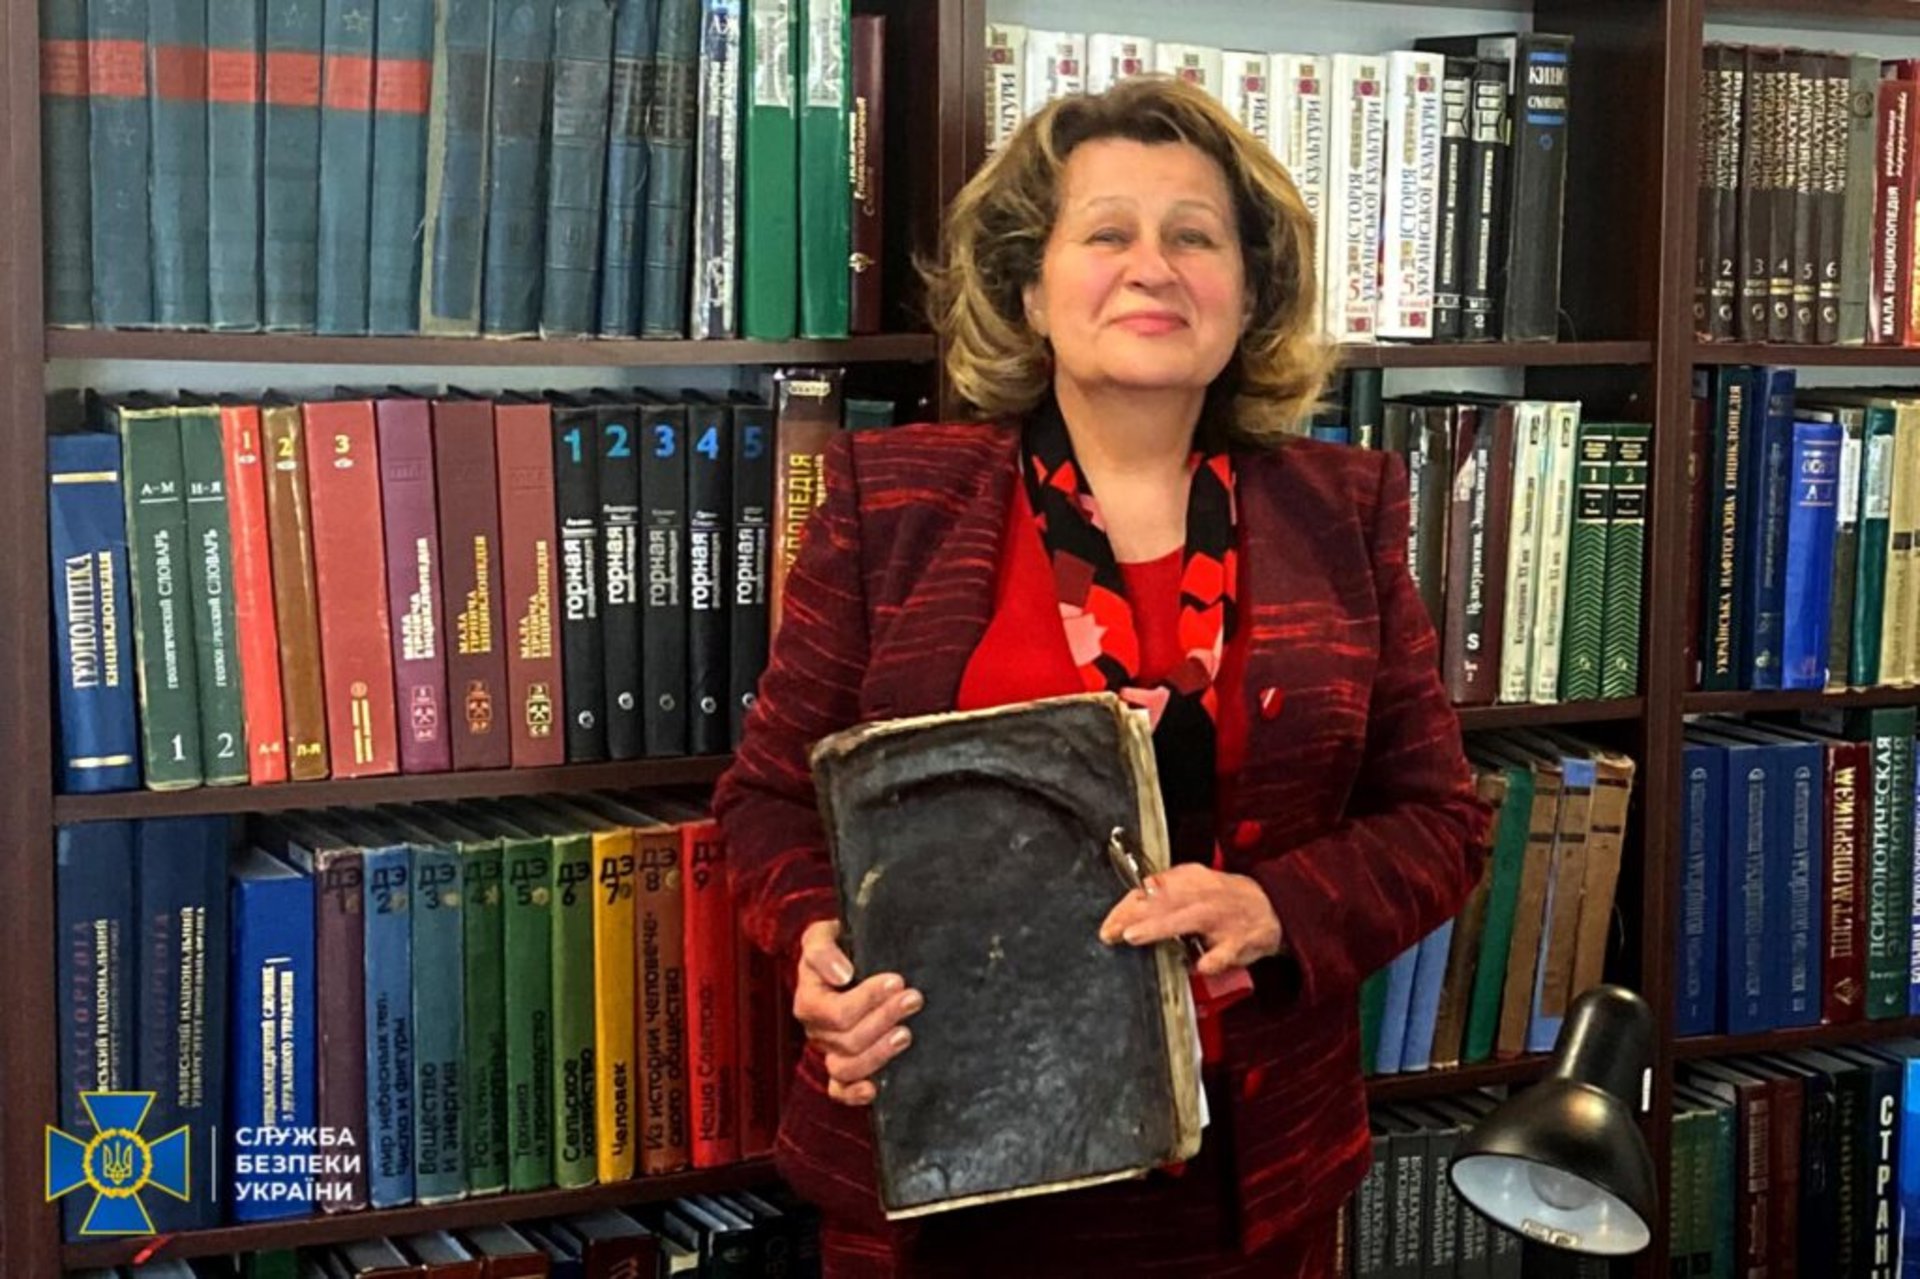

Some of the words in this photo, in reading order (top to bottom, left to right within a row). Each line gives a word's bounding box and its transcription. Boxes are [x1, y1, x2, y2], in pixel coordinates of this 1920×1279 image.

[1000, 73, 1017, 137] ЬТУРИ
[1305, 100, 1322, 185] КУЛЬТУРИ
[1363, 102, 1381, 185] КУЛЬТУРИ
[1418, 98, 1436, 180] КУЛЬТУРИ
[1346, 173, 1363, 244] ІСТОРІЯ
[1399, 169, 1418, 240] ІСТОРІЯ
[1360, 192, 1379, 302] УКРАЇНСЬКОЇ
[1414, 186, 1434, 297] УКРАЇНСЬКОЇ
[1721, 258, 1733, 276] 2
[1754, 258, 1764, 275] 3
[1778, 257, 1789, 274] 4
[1884, 186, 1900, 293] ЕНЦИКЛОПЕДІЯ
[1347, 276, 1361, 301] 5
[1402, 273, 1415, 295] 5
[1803, 263, 1813, 280] 5
[1825, 261, 1837, 278] 6
[1474, 313, 1485, 328] 2
[1884, 295, 1895, 336] МАЛА
[243, 431, 251, 449] 1
[278, 437, 293, 457] 2
[335, 435, 350, 454] 3
[564, 428, 581, 462] 1
[605, 425, 630, 457] 2
[655, 425, 676, 457] 3
[696, 426, 719, 459] 4
[743, 426, 762, 457] 5
[1725, 385, 1741, 490] ЕНЦИКЛОПЕДІЯ
[1590, 468, 1597, 481] 1
[1625, 467, 1634, 482] 2
[786, 453, 813, 573] КЛОПЕДІЯ
[1720, 496, 1737, 588] НАФТОГАЗОВА
[153, 530, 172, 596] СЛОВАРЬ
[203, 529, 222, 595] СЛОВАРЬ
[561, 539, 585, 620] горная
[605, 526, 627, 605] горная
[648, 530, 668, 606] горная
[689, 533, 710, 610] горная
[735, 528, 755, 605] горная
[65, 553, 98, 688] ГЕОПОЛІТИКА
[98, 551, 118, 687] ЕНЦИКЛОПЕДІЯ
[417, 538, 435, 658] ЕНЦИКЛОПЕДІЯ
[466, 590, 480, 653] ГІРНИЧА
[474, 535, 492, 652] ЕНЦИКЛОПЕДІЯ
[536, 540, 552, 657] ЕНЦИКЛОПЕДІЯ
[402, 614, 415, 660] МАЛА
[409, 594, 425, 659] ГІРНИЧА
[457, 613, 469, 654] МАЛА
[519, 616, 531, 659] МАЛА
[528, 594, 541, 658] ГІРНИЧА
[1714, 592, 1732, 675] УКРАЇНСЬКА
[171, 735, 186, 761] 1
[217, 732, 235, 758] 2
[510, 857, 548, 884] ДЭ
[557, 861, 590, 886] ДЭ
[599, 854, 634, 881] ДЭ
[638, 847, 677, 873] ДЭ
[1830, 767, 1856, 958] ПОСТМОДЕРНИЗМ
[1870, 735, 1891, 958] ПСИХОЛОГИЧЕСКАЯ
[370, 866, 407, 893] ДЭ
[376, 891, 392, 914] 2
[417, 863, 456, 890] ДЭ
[426, 889, 440, 910] 3
[517, 885, 530, 907] 5
[561, 884, 575, 906] 6
[605, 881, 621, 905] 7
[645, 869, 661, 892] 8
[694, 866, 707, 891] 9
[94, 919, 109, 1035] НАЦІОНАЛЬНИЙ
[179, 907, 194, 1021] НАЦІОНАЛЬНИЙ
[662, 968, 681, 1082] общества
[95, 1037, 109, 1092] ВСЬКИЙ
[261, 1020, 277, 1130] НЦИКЛОПЕДИЧНИЙ
[646, 1029, 668, 1120] истории
[418, 1062, 439, 1175] Вещество
[443, 1062, 463, 1151] энергия
[514, 1084, 530, 1158] Техника
[562, 1060, 581, 1164] Сельское
[611, 1063, 627, 1157] Человек
[443, 1158, 457, 1173] и
[646, 1124, 664, 1152] Из
